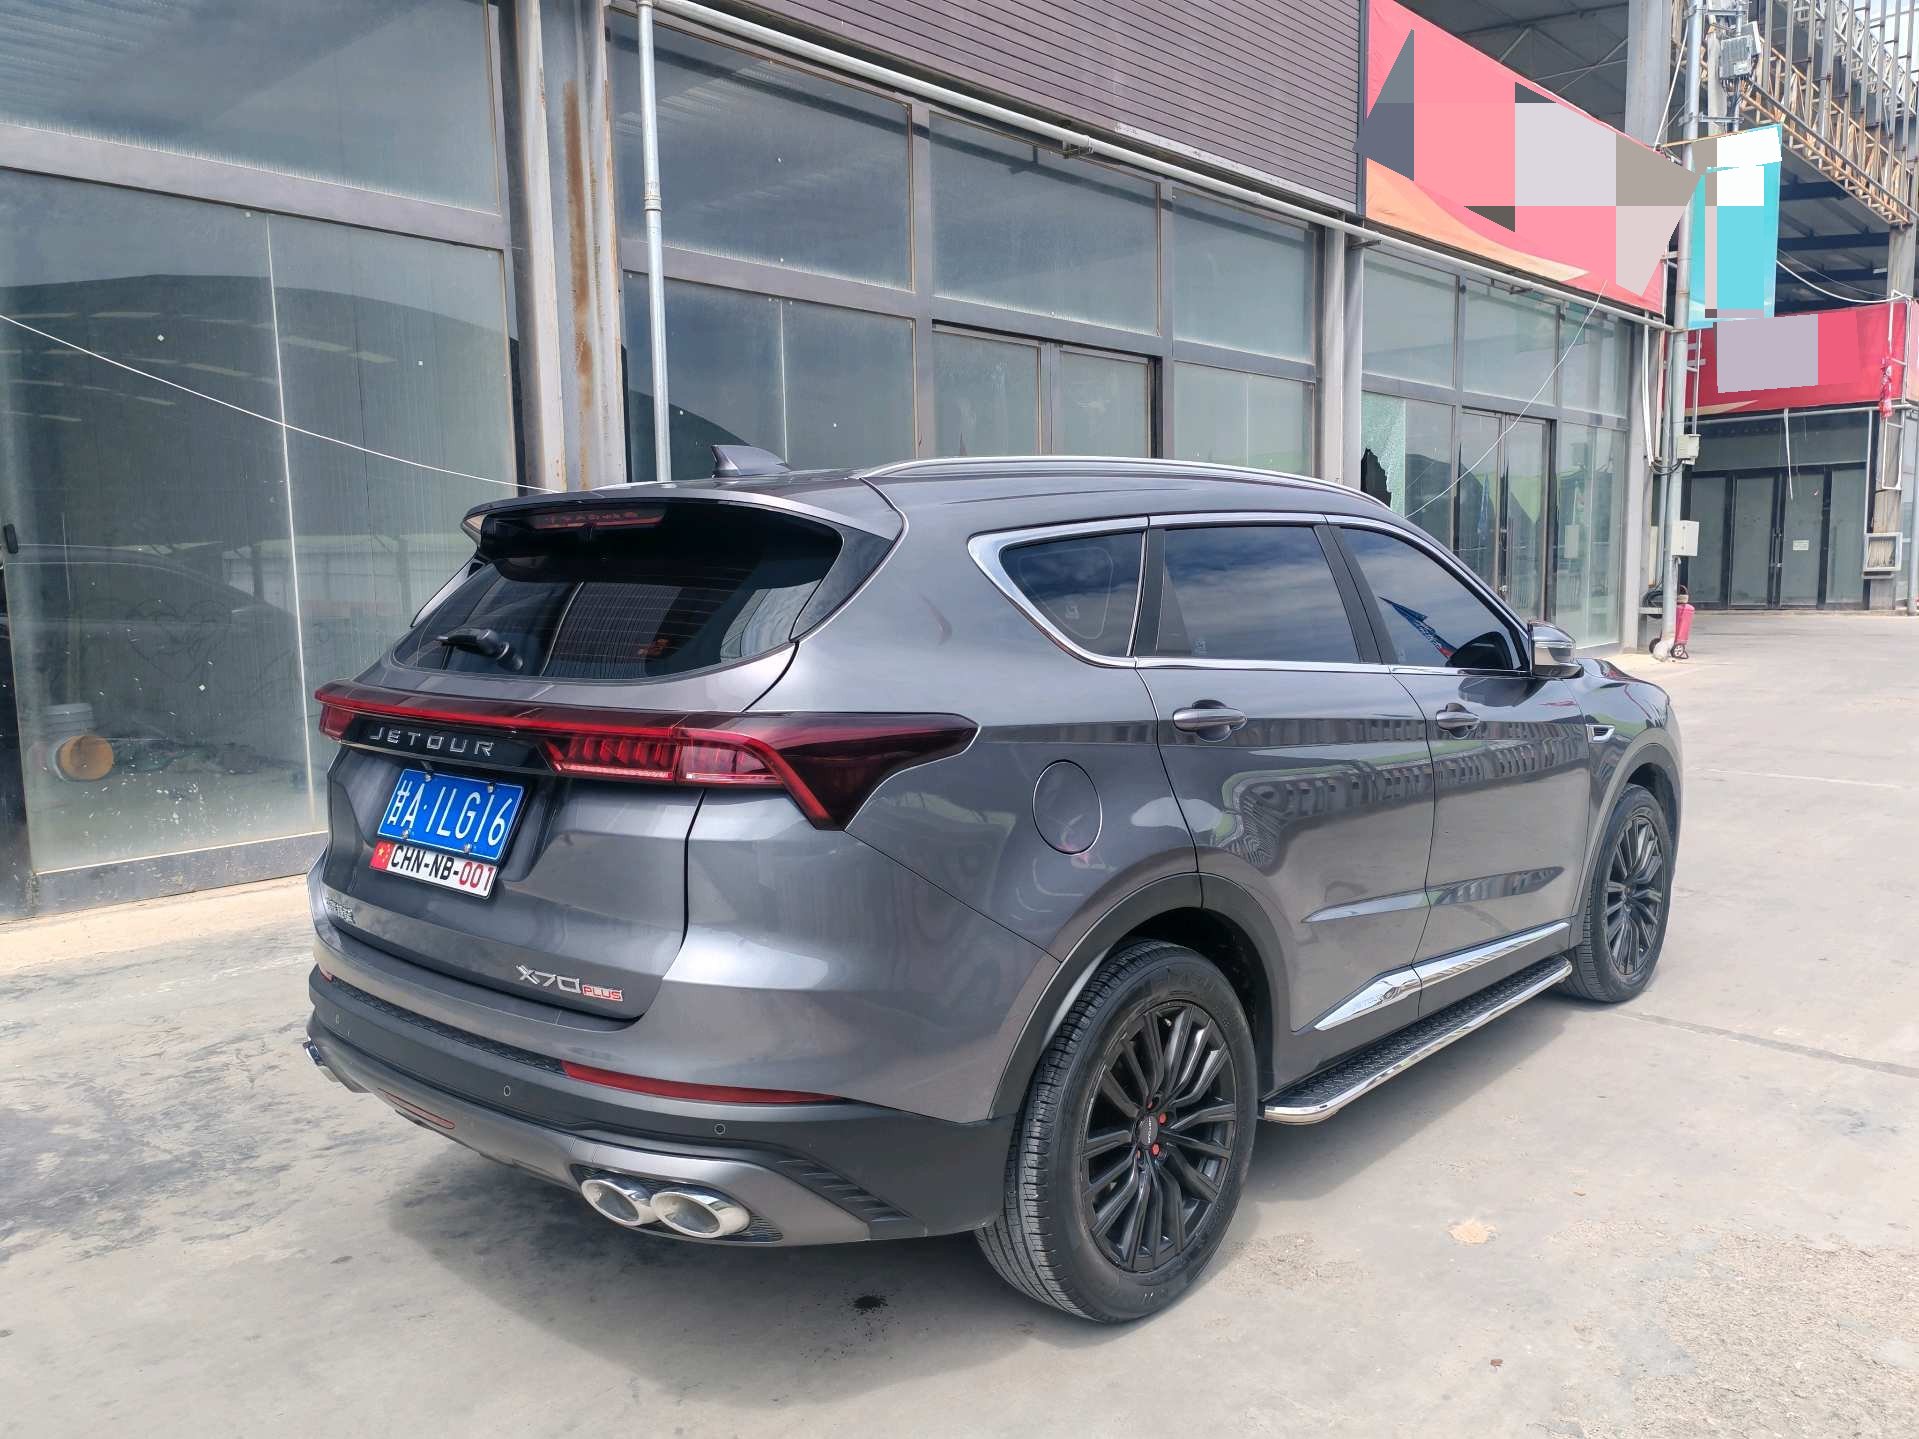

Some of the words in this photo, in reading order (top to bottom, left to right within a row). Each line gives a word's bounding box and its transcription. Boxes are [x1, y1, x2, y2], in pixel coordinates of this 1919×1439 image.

[369, 726, 495, 756] JETOUR
[390, 845, 495, 892] CHN-NB-001
[516, 964, 581, 994] X70
[582, 985, 622, 1001] PLUS
